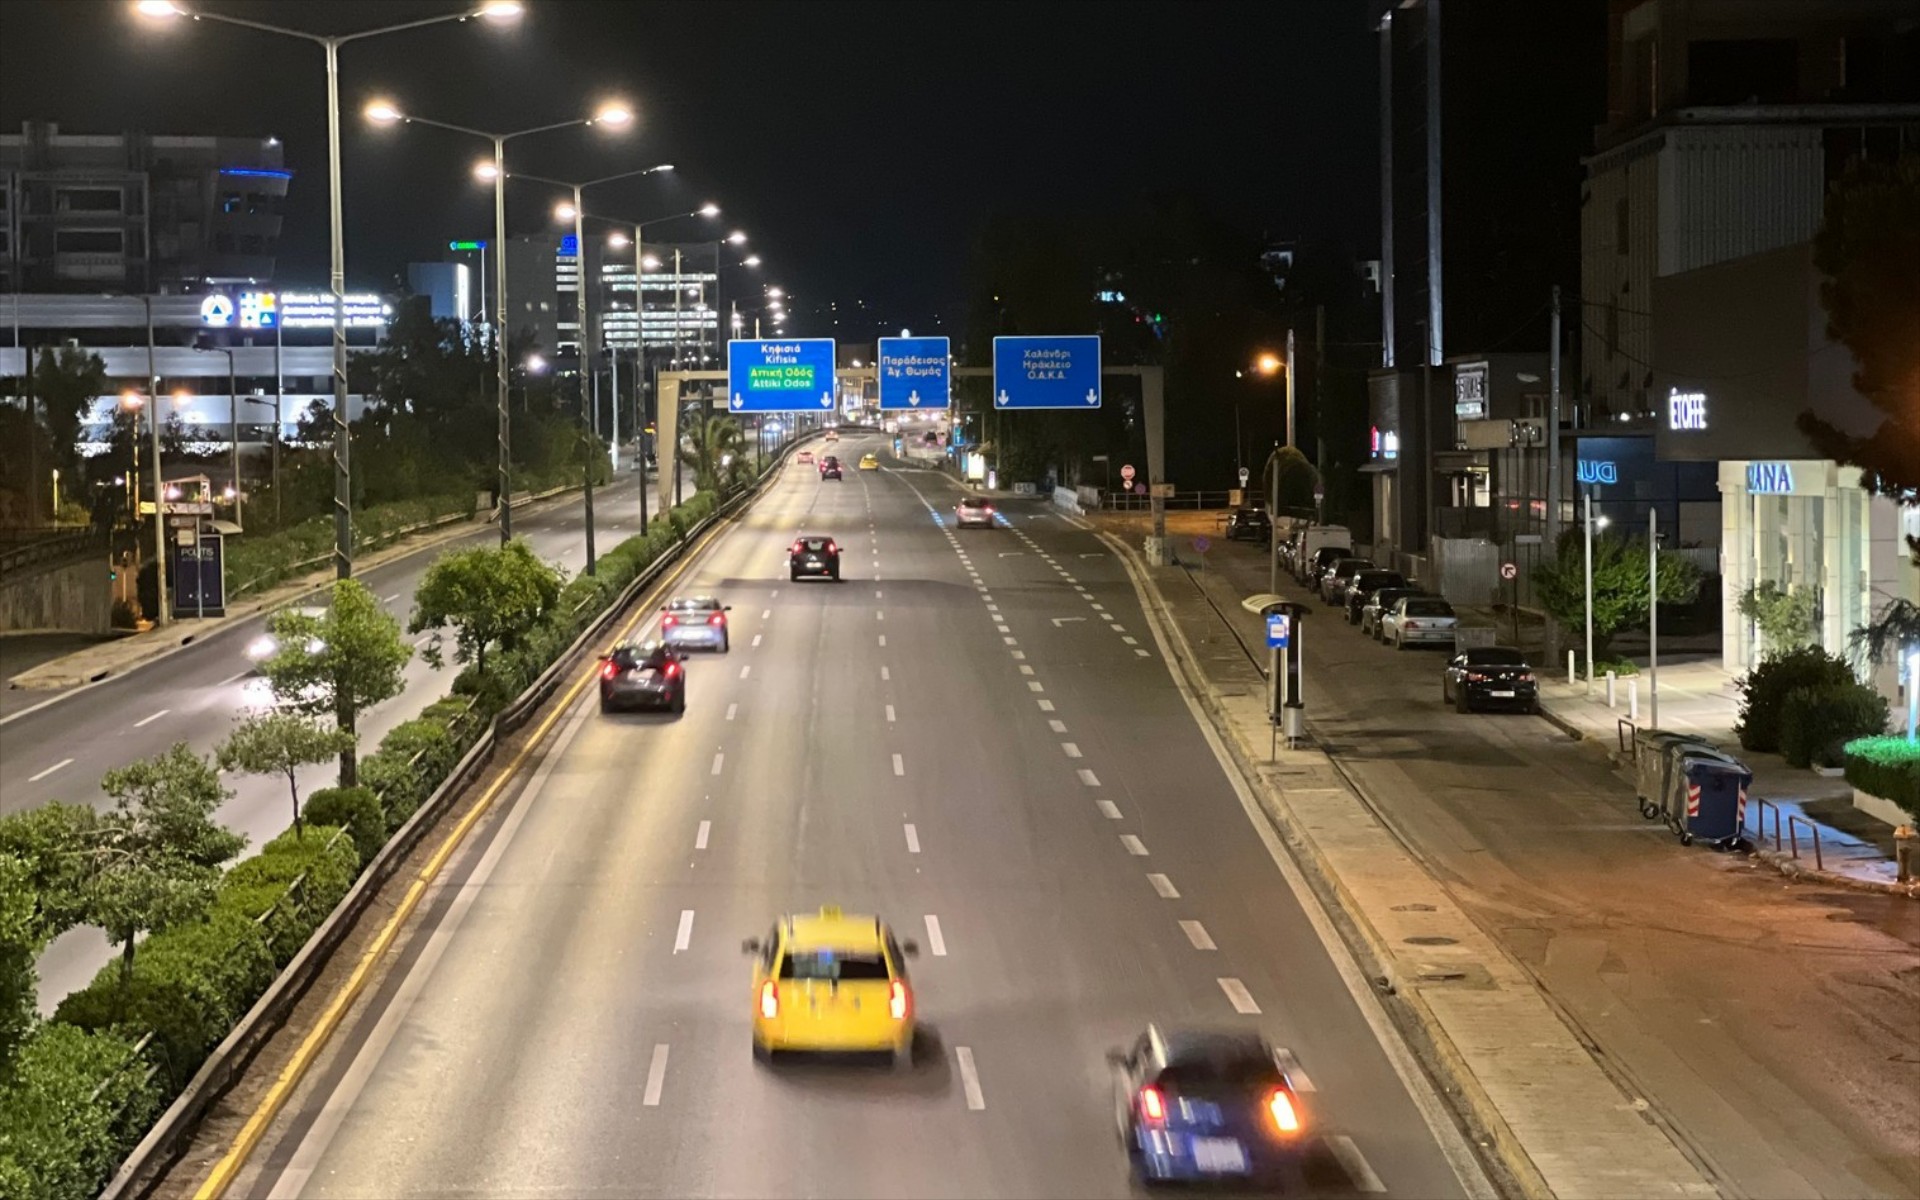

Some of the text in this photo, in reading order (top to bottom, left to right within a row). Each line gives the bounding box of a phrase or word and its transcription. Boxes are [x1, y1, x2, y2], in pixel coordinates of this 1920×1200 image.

[761, 344, 801, 354] Κηφισιά
[765, 354, 798, 364] Kifisia
[785, 367, 813, 378] Οδός
[753, 378, 811, 387] Attiki Odos
